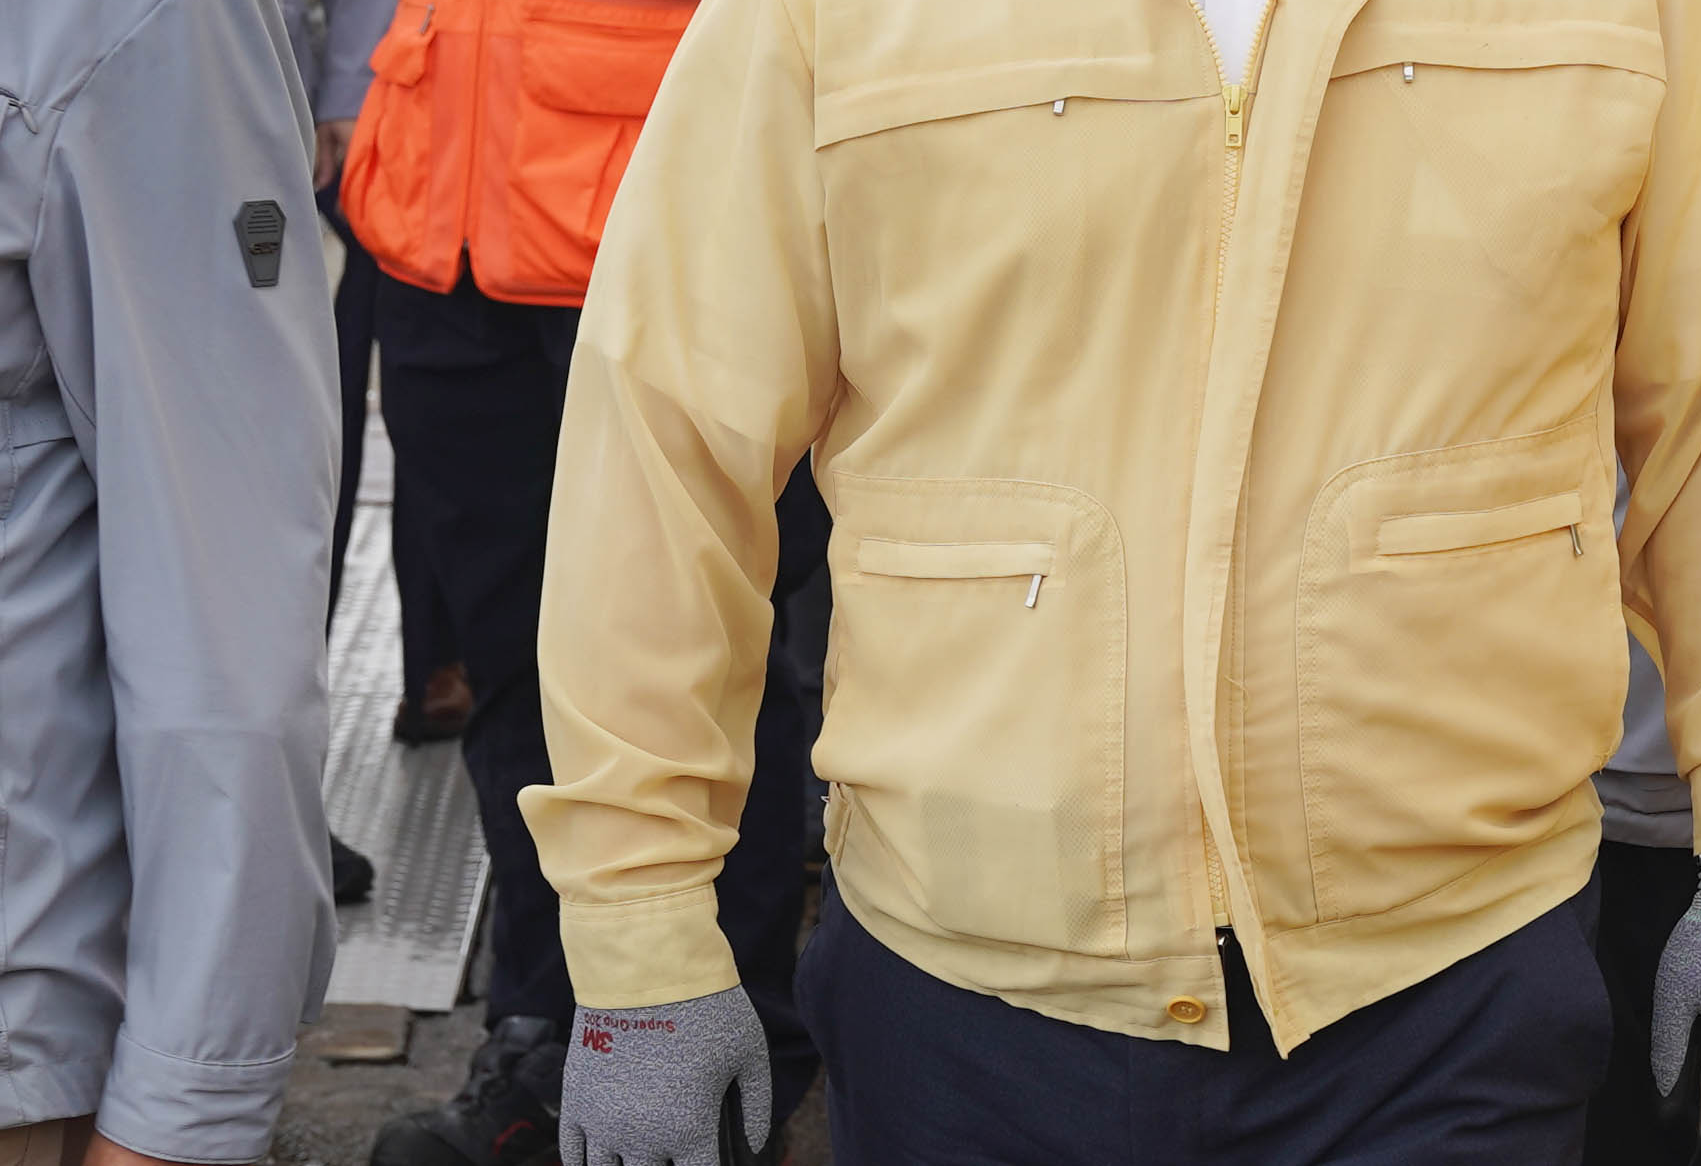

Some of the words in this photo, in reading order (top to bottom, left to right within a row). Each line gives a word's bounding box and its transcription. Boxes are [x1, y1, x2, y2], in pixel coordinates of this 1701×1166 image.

[603, 1013, 630, 1033] Grip
[632, 1017, 677, 1034] Super
[582, 1025, 614, 1055] 3M
